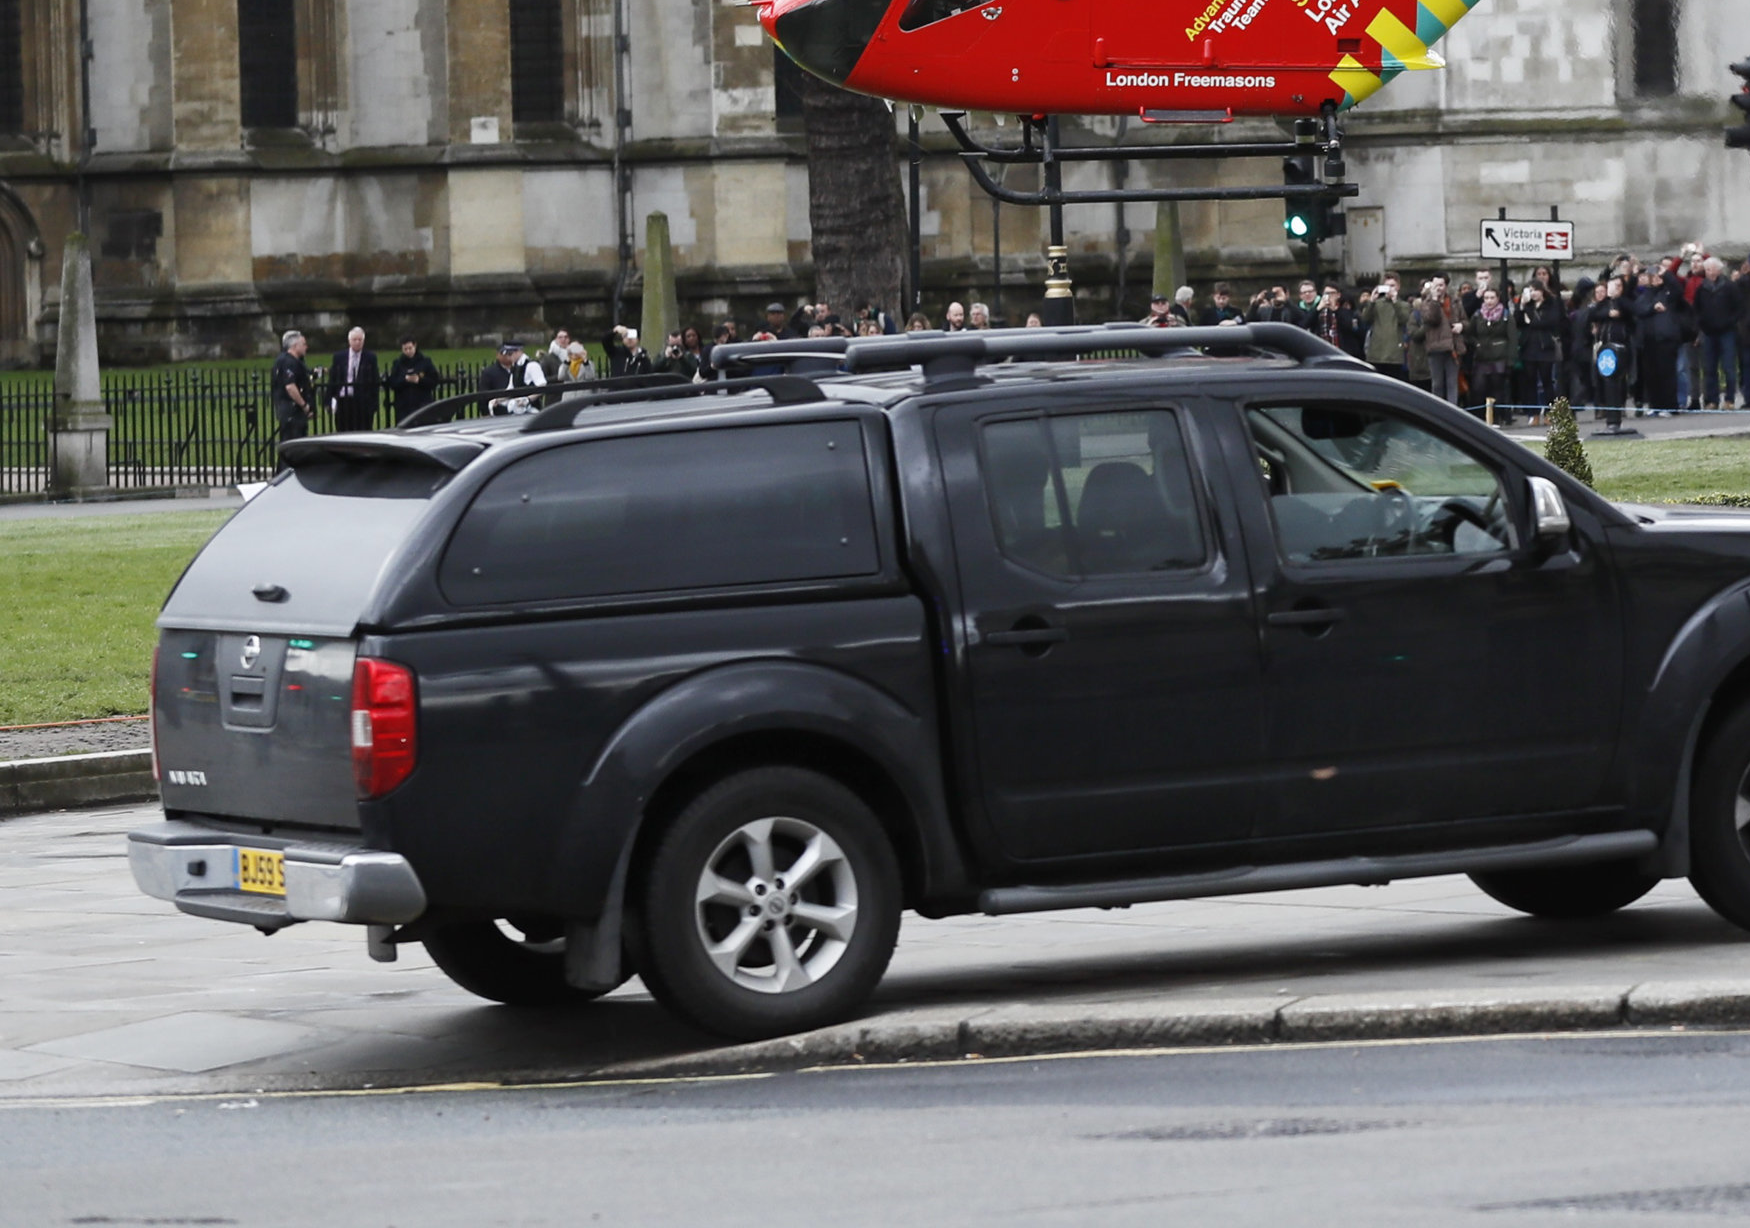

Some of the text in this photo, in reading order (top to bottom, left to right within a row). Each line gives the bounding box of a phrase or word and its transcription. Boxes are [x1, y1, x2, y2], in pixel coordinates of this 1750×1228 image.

[1324, 4, 1352, 36] Air
[1105, 72, 1276, 88] London Freemasons
[1503, 227, 1542, 240] Victoria
[1503, 240, 1541, 253] Station
[241, 853, 275, 886] BJ59
